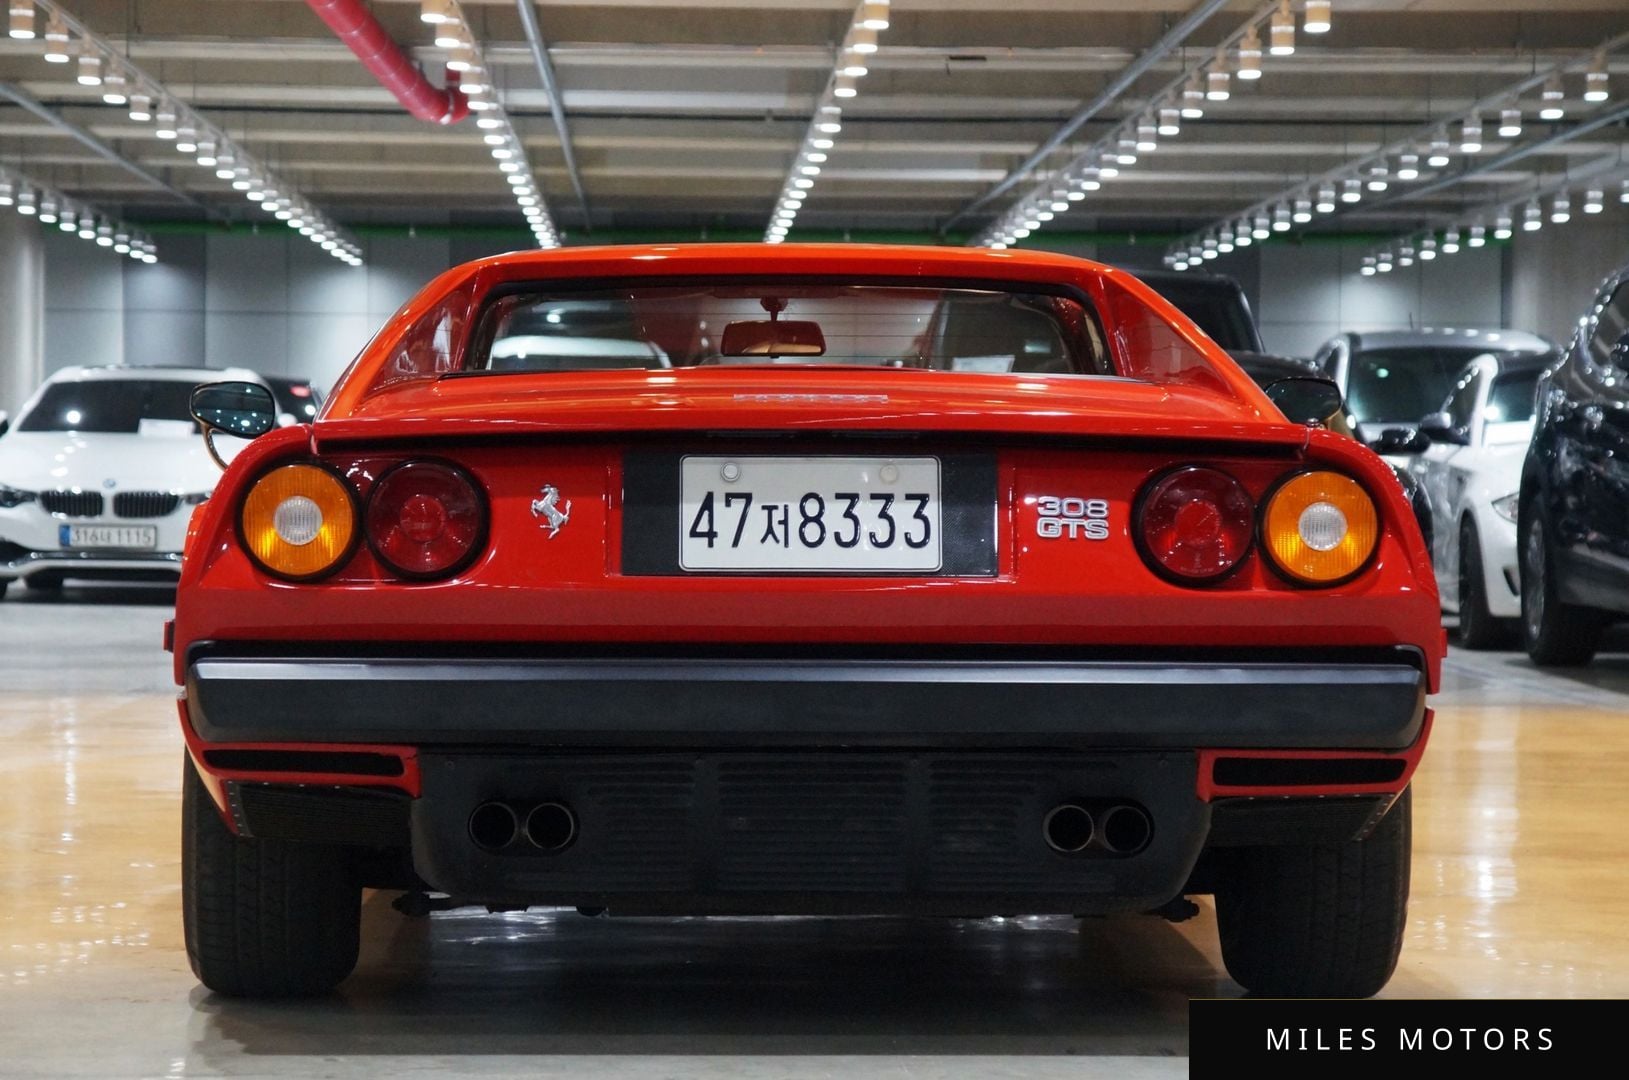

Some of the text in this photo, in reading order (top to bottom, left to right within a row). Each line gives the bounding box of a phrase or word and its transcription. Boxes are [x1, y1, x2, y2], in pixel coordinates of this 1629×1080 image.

[1037, 496, 1109, 518] 308
[689, 491, 931, 549] 47저8333
[1037, 516, 1109, 539] GTS
